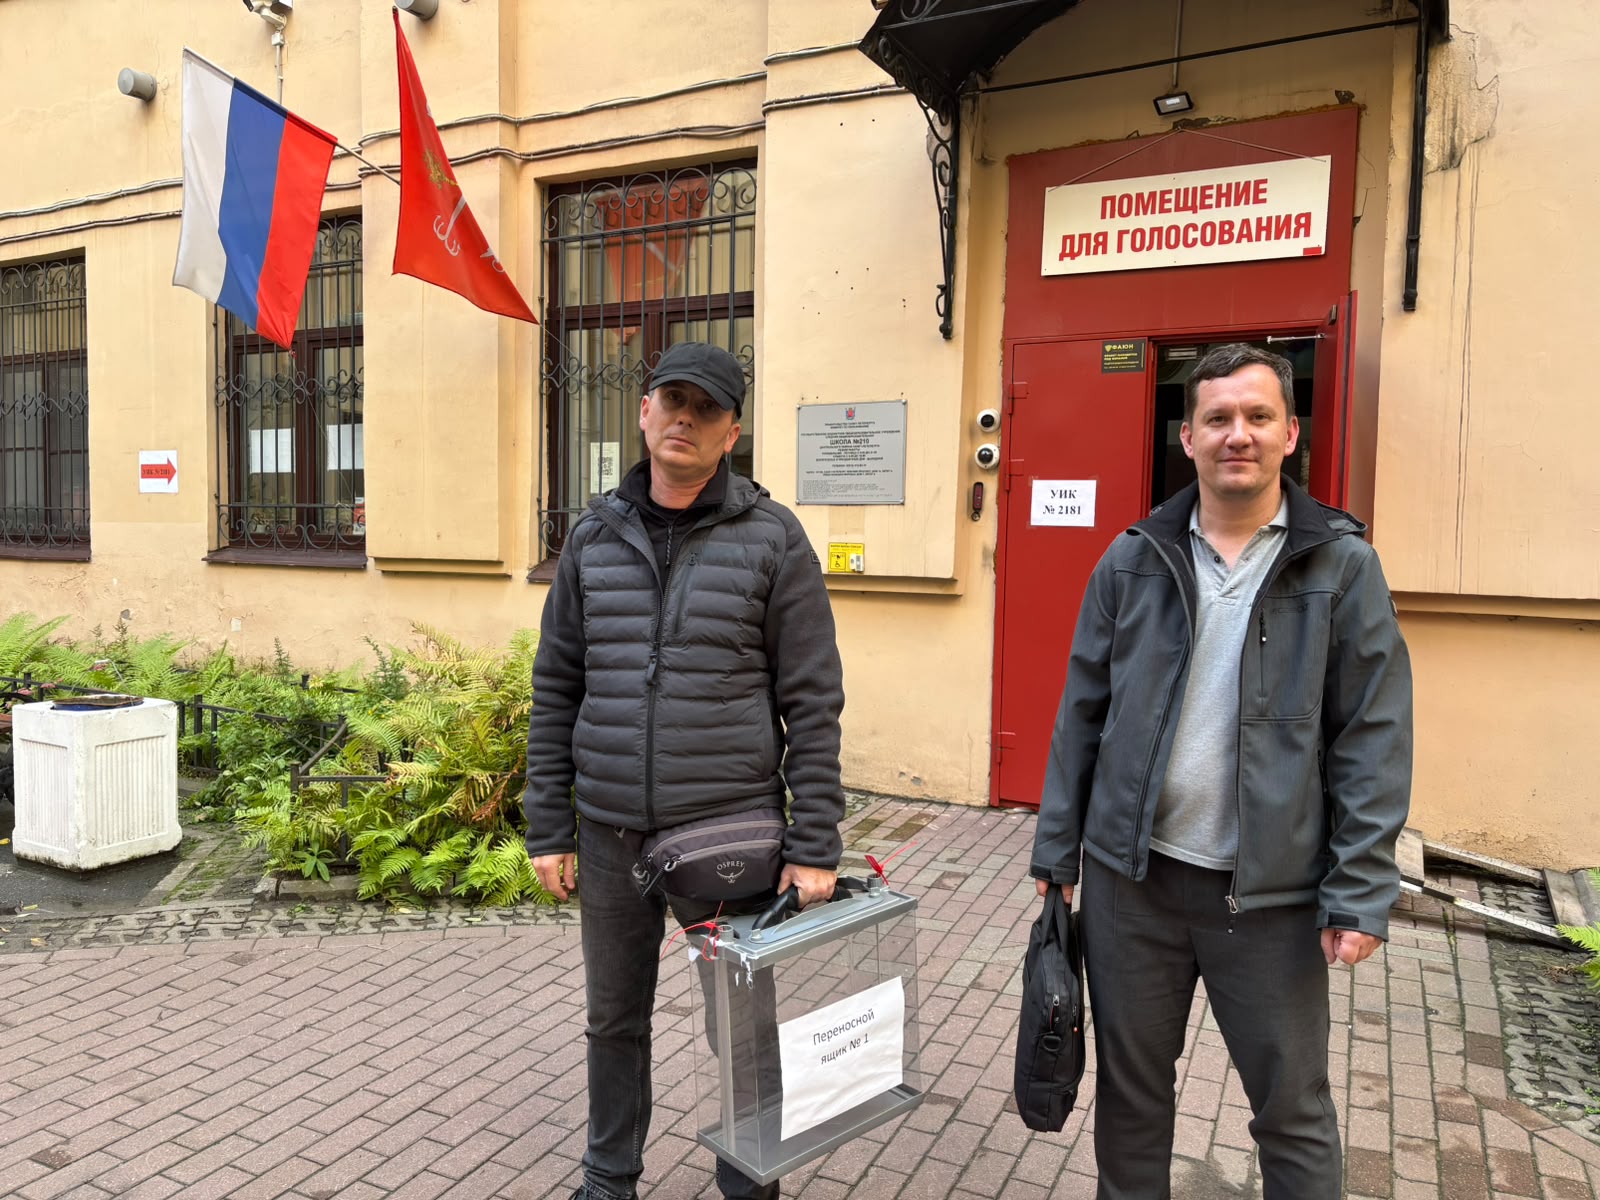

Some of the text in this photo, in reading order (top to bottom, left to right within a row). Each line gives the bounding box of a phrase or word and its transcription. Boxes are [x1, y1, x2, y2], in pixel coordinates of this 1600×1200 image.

[1100, 178, 1268, 220] ПОМЕЩЕНИЕ
[1059, 212, 1312, 262] ДЛЯ ГОЛОСОВАНИЯ
[1043, 504, 1081, 515] № 2181
[1050, 489, 1077, 499] УИК
[716, 860, 745, 871] OSPREY
[812, 1008, 875, 1046] Переносной
[820, 1032, 869, 1065] ящик № 1
